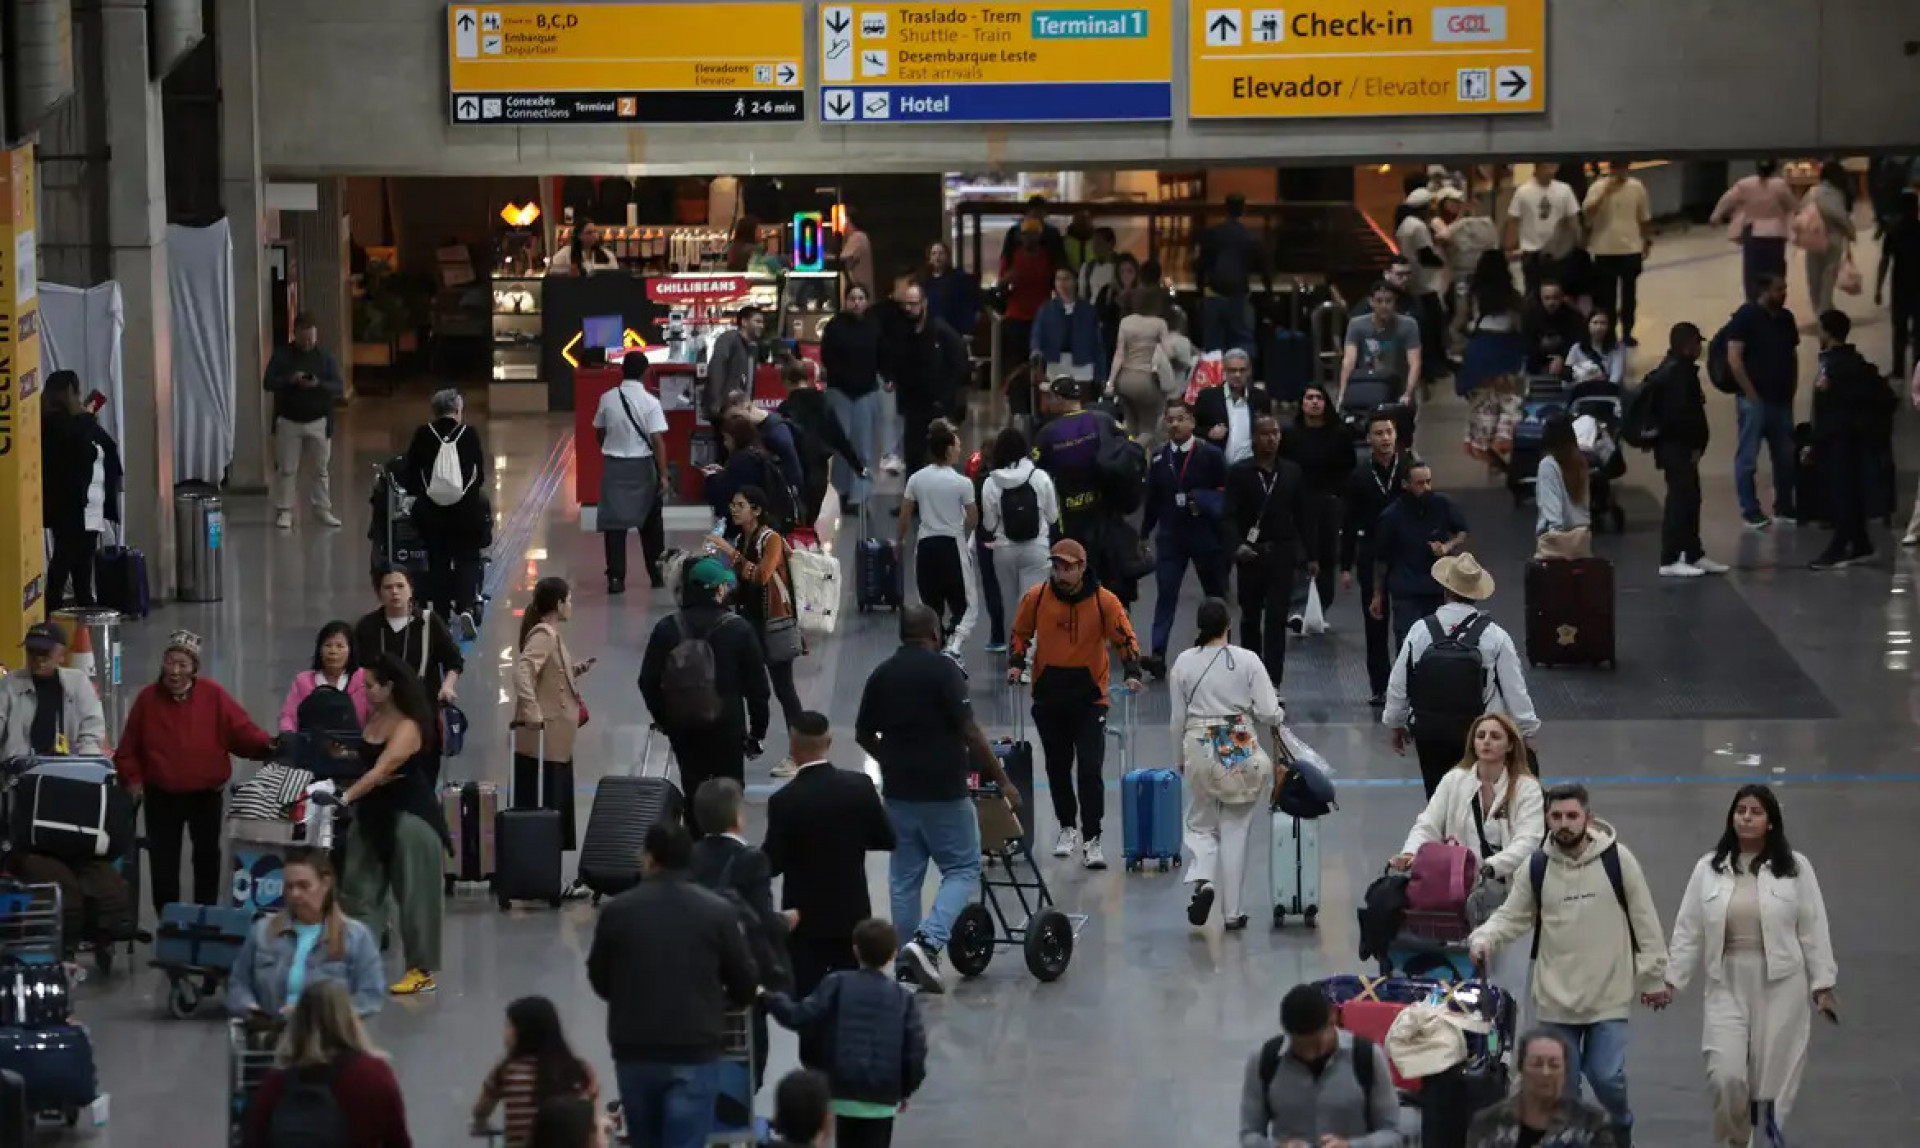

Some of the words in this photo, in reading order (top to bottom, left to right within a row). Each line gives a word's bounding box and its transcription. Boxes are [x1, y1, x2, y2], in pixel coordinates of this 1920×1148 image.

[536, 14, 578, 30] B,C,D
[899, 8, 967, 23] Traslado
[981, 9, 1021, 23] Trem
[1036, 15, 1127, 34] Terminal
[1131, 12, 1142, 34] 1
[1292, 11, 1412, 37] Check-in
[505, 33, 557, 44] Embarque
[900, 28, 958, 42] Shuttle
[973, 28, 1011, 42] Train
[505, 45, 558, 56] Departure
[899, 49, 997, 65] Desembarque
[1000, 49, 1037, 62] Leste
[695, 64, 749, 74] Elevadores
[899, 67, 927, 79] East
[932, 67, 983, 79] arrivals
[695, 76, 736, 86] Elevator
[1233, 74, 1342, 98] Elevador
[1365, 77, 1450, 96] Elevator
[506, 95, 556, 106] Conexões
[575, 102, 615, 112] Terminal
[621, 99, 633, 115] 2
[751, 101, 772, 113] 2-6
[774, 102, 795, 113] min
[901, 95, 949, 112] Hotel
[506, 108, 570, 119] Connections
